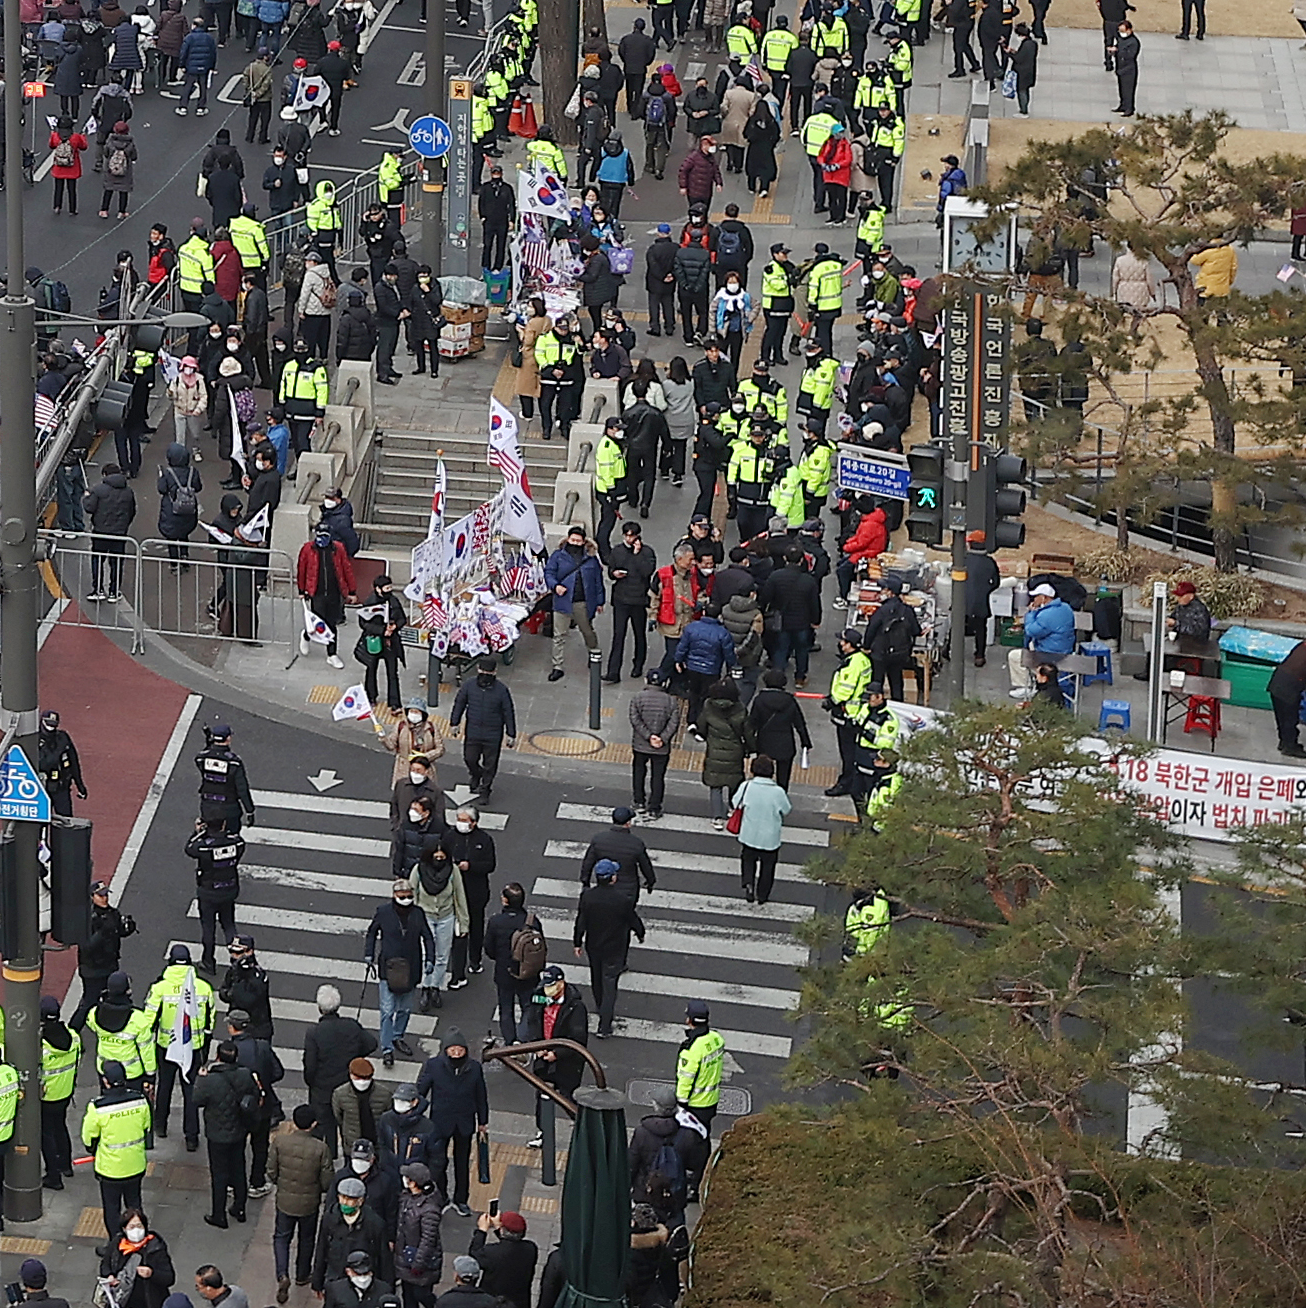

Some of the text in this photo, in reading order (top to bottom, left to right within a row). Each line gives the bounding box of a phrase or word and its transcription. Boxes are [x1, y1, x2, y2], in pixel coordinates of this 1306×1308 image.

[841, 459, 897, 480] 세종대로20길
[1154, 762, 1210, 794] 북한군
[1216, 769, 1253, 795] 개입
[1212, 802, 1248, 829] 법치
